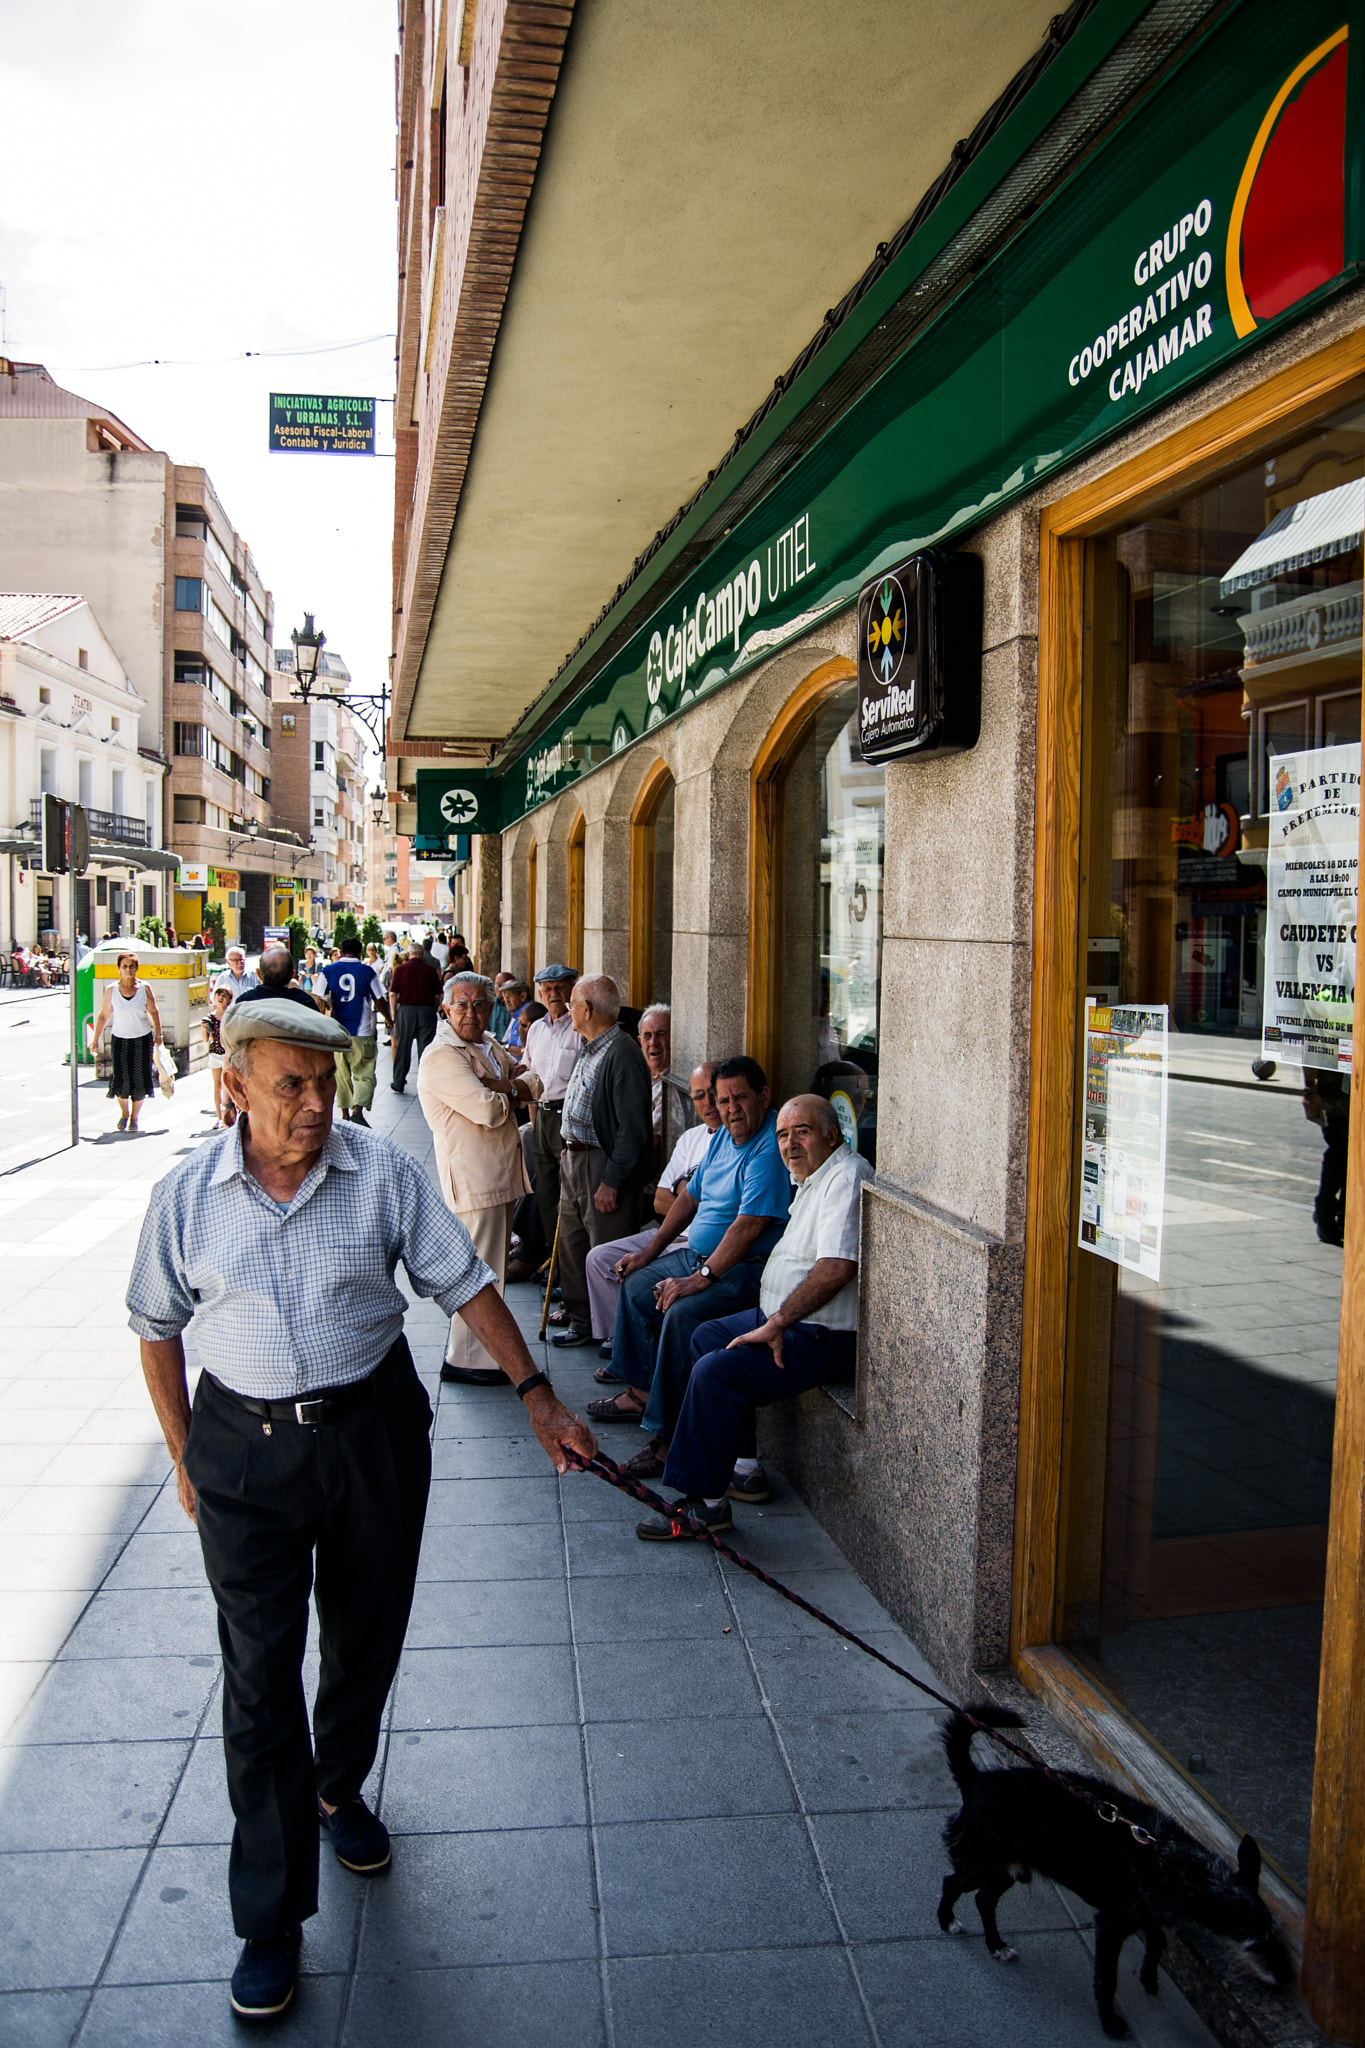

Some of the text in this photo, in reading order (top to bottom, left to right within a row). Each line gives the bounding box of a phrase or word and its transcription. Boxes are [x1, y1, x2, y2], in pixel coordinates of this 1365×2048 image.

[1134, 199, 1212, 286] GRUPO
[1068, 251, 1212, 386] COOPERATIVO
[1109, 303, 1213, 401] CAJAMAR
[274, 396, 373, 412] INICIATIVAS AGRICOLAS
[285, 411, 362, 426] Y URBANAS, S.L.
[313, 425, 373, 439] Fiscal-Laboral
[280, 436, 319, 448] Contable
[323, 440, 328, 451] y
[665, 512, 816, 691] CajaCampo UTIEL
[861, 679, 915, 728] ServiRed
[861, 726, 880, 745] Cajero
[1324, 787, 1340, 800] DE
[1281, 803, 1360, 837] PRETEMPOR
[1285, 859, 1326, 870] MIÉRCOLES
[1327, 860, 1336, 869] 18
[1337, 859, 1347, 868] DE
[1310, 873, 1350, 883] A LAS 19:00
[1278, 888, 1302, 897] CAMPO
[1302, 887, 1343, 897] MUNICIPAL
[1344, 888, 1353, 896] EL
[1280, 924, 1346, 943] CAUDETE
[1316, 954, 1333, 972] VS
[339, 973, 356, 1002] 9
[1275, 980, 1347, 1003] VALENCIA
[1089, 1012, 1110, 1026] XXIV
[1276, 1016, 1302, 1026] JUVENIL
[1335, 1022, 1345, 1031] DE
[1089, 1036, 1118, 1055] VUELTA
[1304, 1034, 1339, 1045] TEMPORADA
[1088, 1090, 1106, 1104] UTIEL
